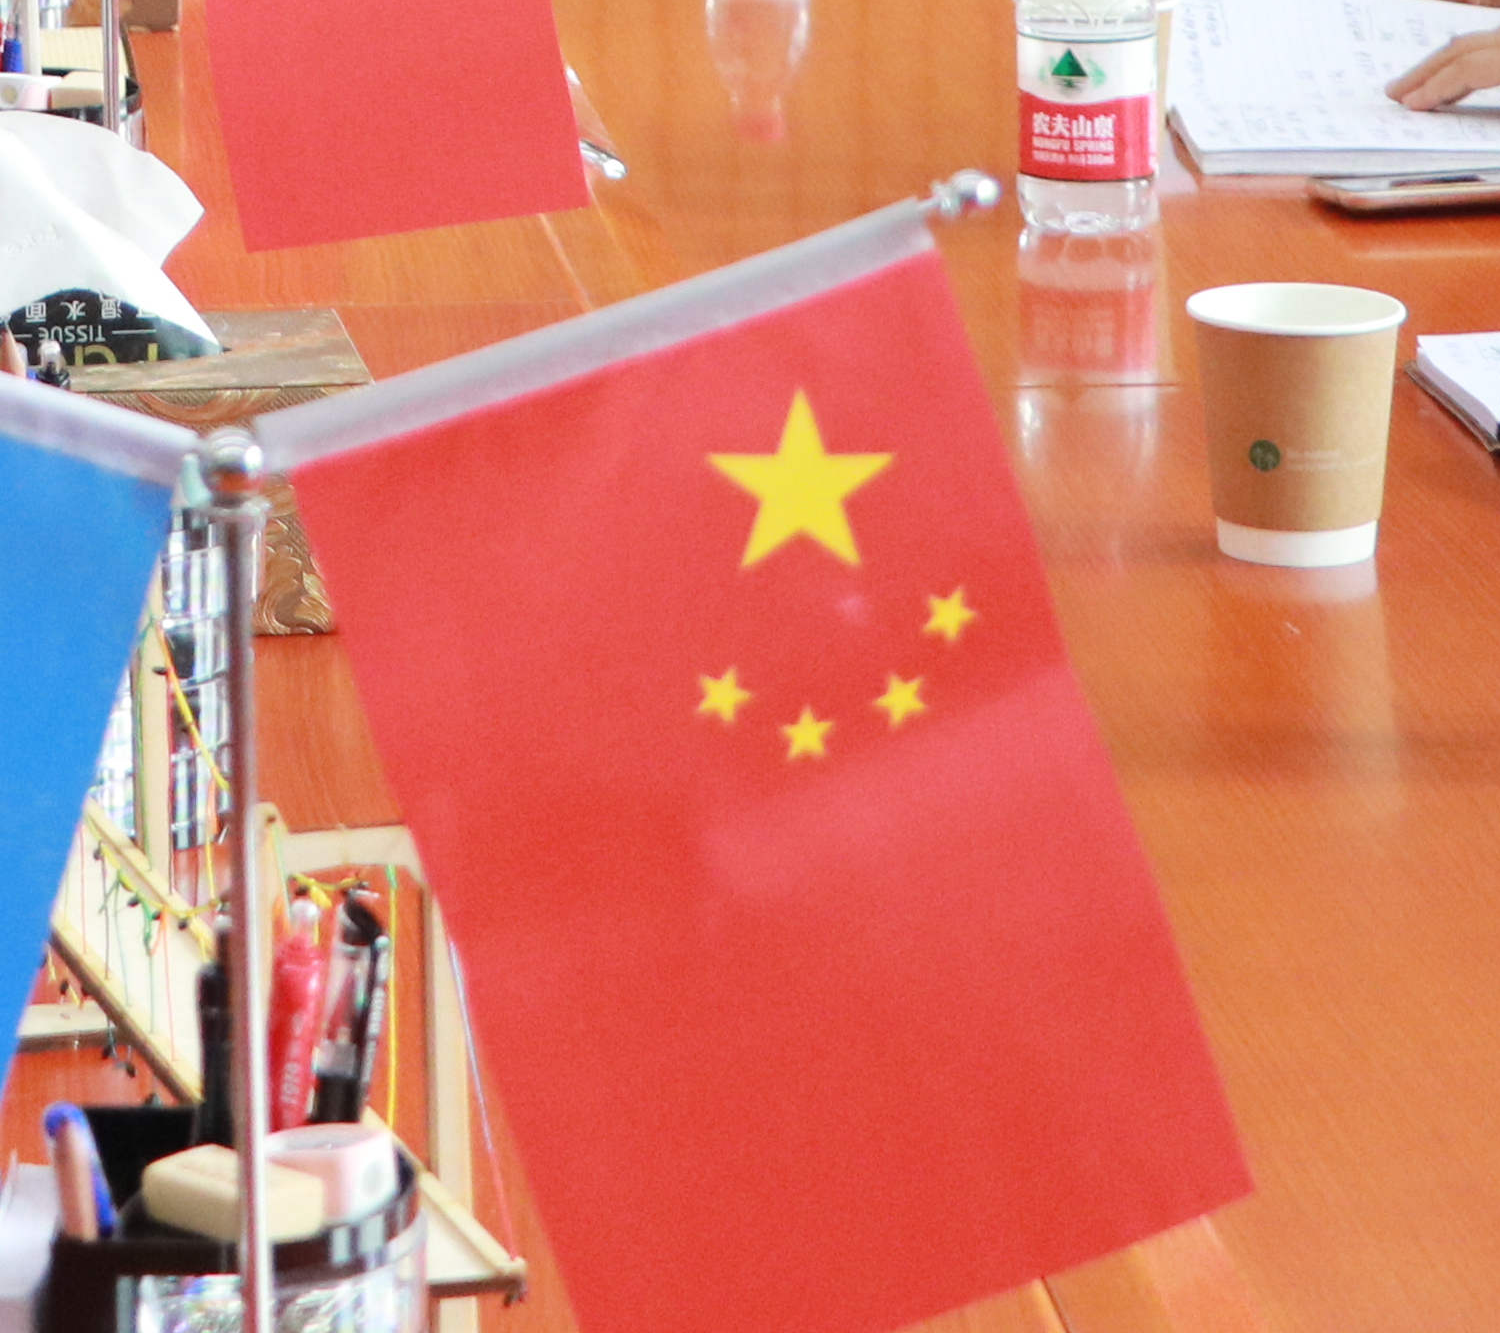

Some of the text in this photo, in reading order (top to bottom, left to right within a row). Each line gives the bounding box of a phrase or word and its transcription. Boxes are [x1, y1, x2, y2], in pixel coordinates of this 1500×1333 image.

[1032, 111, 1114, 137] 农夫山泉
[38, 324, 106, 343] TISSUE
